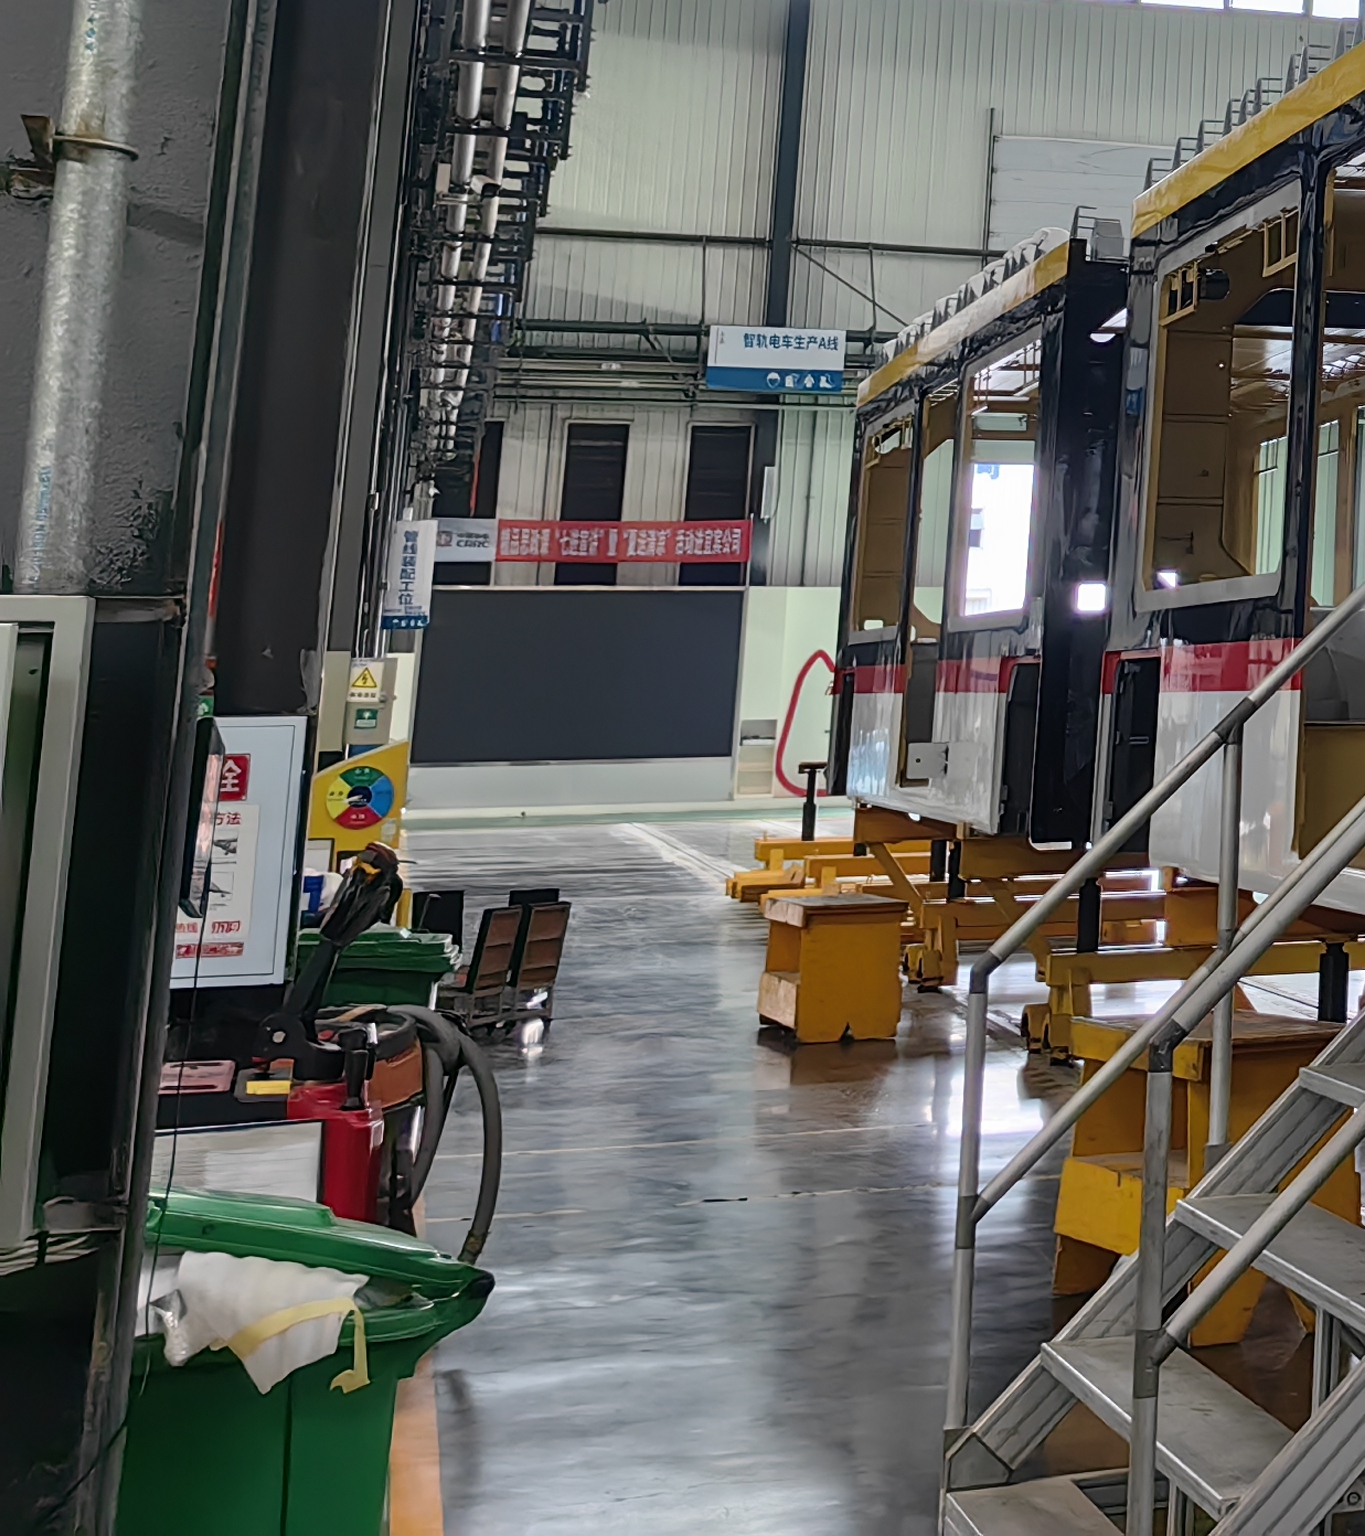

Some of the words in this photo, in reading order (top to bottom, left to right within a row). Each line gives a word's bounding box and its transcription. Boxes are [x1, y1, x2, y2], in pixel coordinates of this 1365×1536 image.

[743, 332, 839, 351] 智轨电车生产A线
